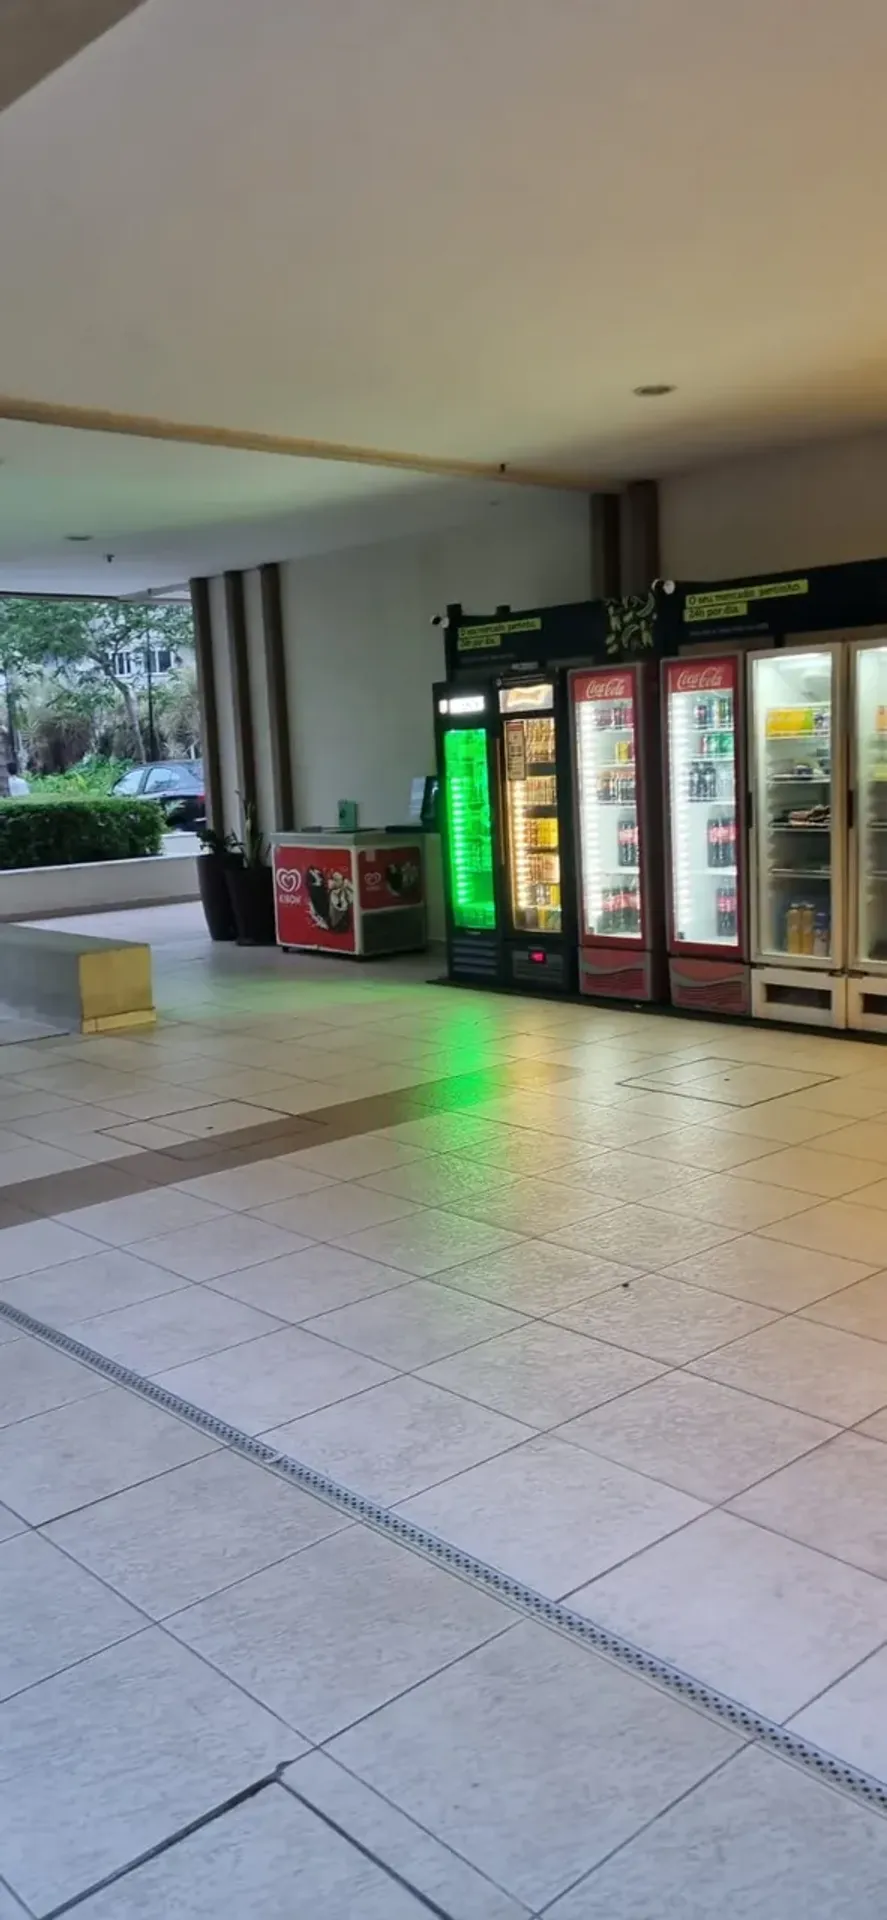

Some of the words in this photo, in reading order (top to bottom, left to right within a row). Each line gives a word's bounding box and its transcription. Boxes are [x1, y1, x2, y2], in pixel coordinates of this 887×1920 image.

[689, 595, 696, 605] O
[698, 595, 714, 603] seu
[688, 606, 705, 618] 24h
[706, 606, 721, 616] por
